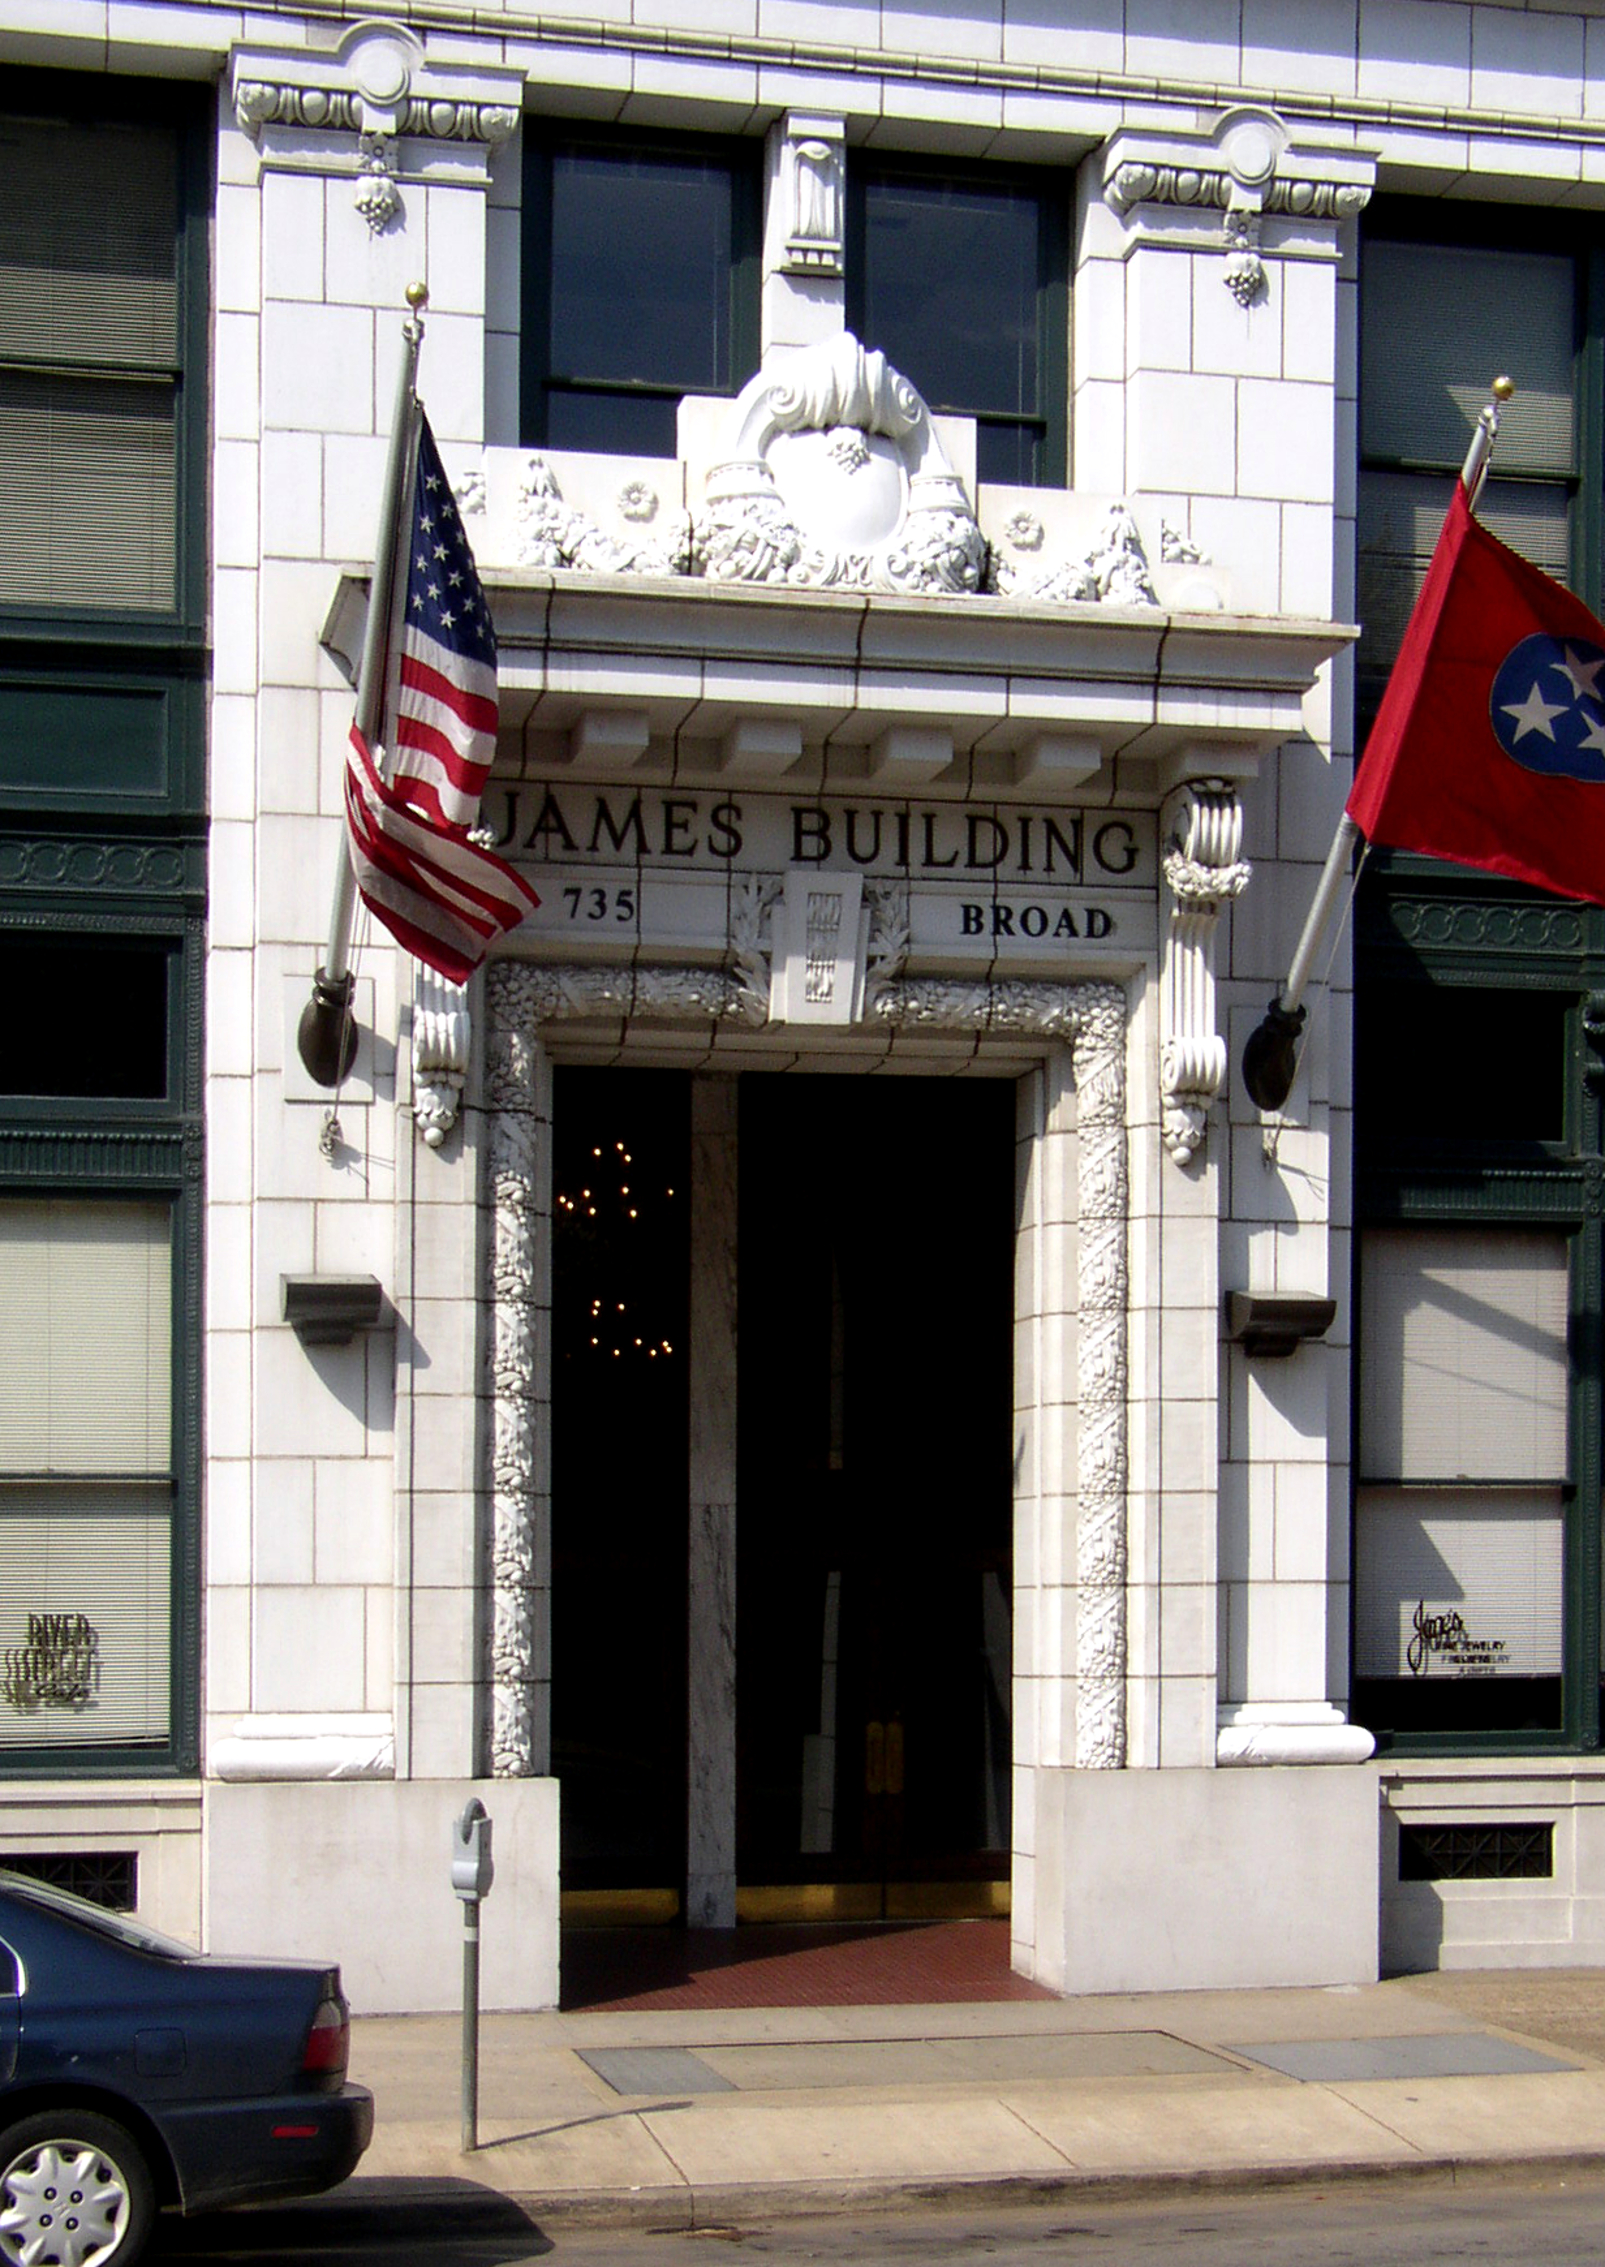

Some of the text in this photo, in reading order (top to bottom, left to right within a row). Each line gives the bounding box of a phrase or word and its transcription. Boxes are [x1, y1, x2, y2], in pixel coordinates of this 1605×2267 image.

[496, 792, 1140, 874] JAMES BUILDING
[563, 887, 1113, 940] 735 BROAD
[28, 1612, 90, 1646] RIVER
